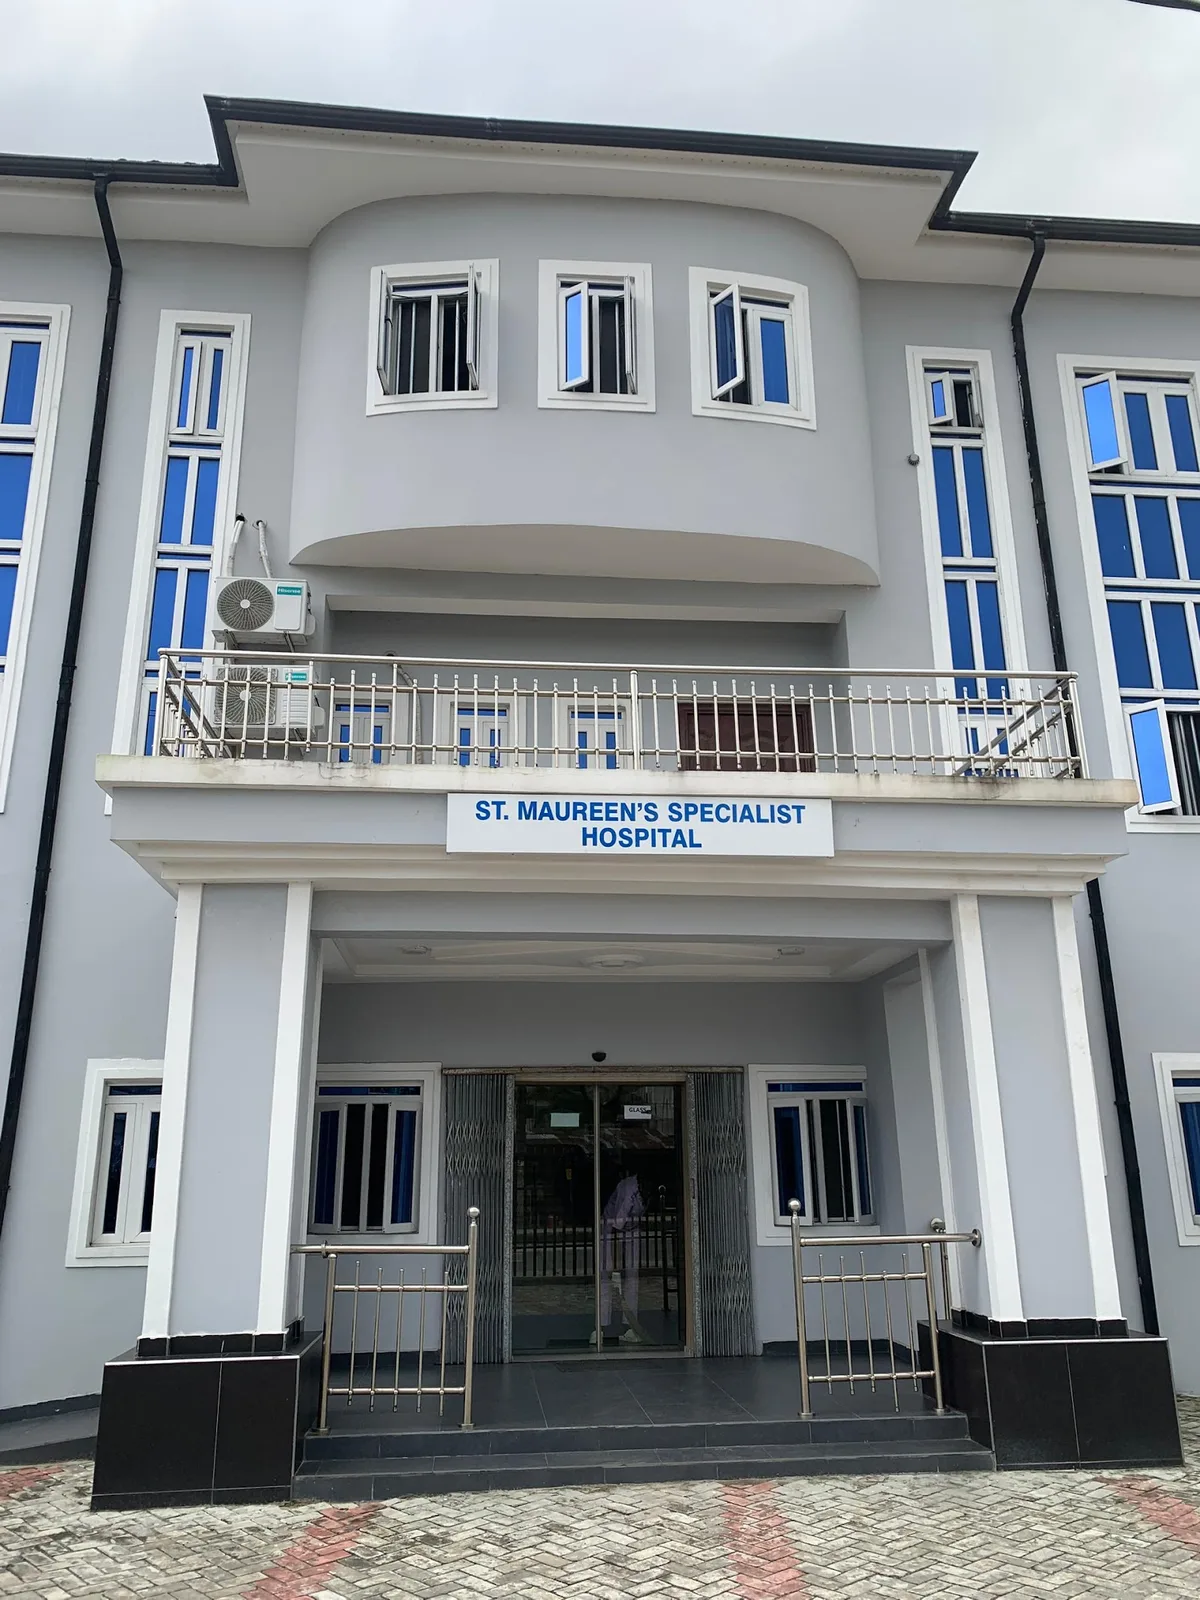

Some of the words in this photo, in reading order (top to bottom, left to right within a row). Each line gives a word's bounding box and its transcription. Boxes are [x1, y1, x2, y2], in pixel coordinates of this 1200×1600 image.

[475, 799, 509, 821] ST.
[517, 800, 659, 823] MAUREEN'S
[667, 801, 805, 825] SPECIALIST
[581, 826, 703, 849] HOSPITAL
